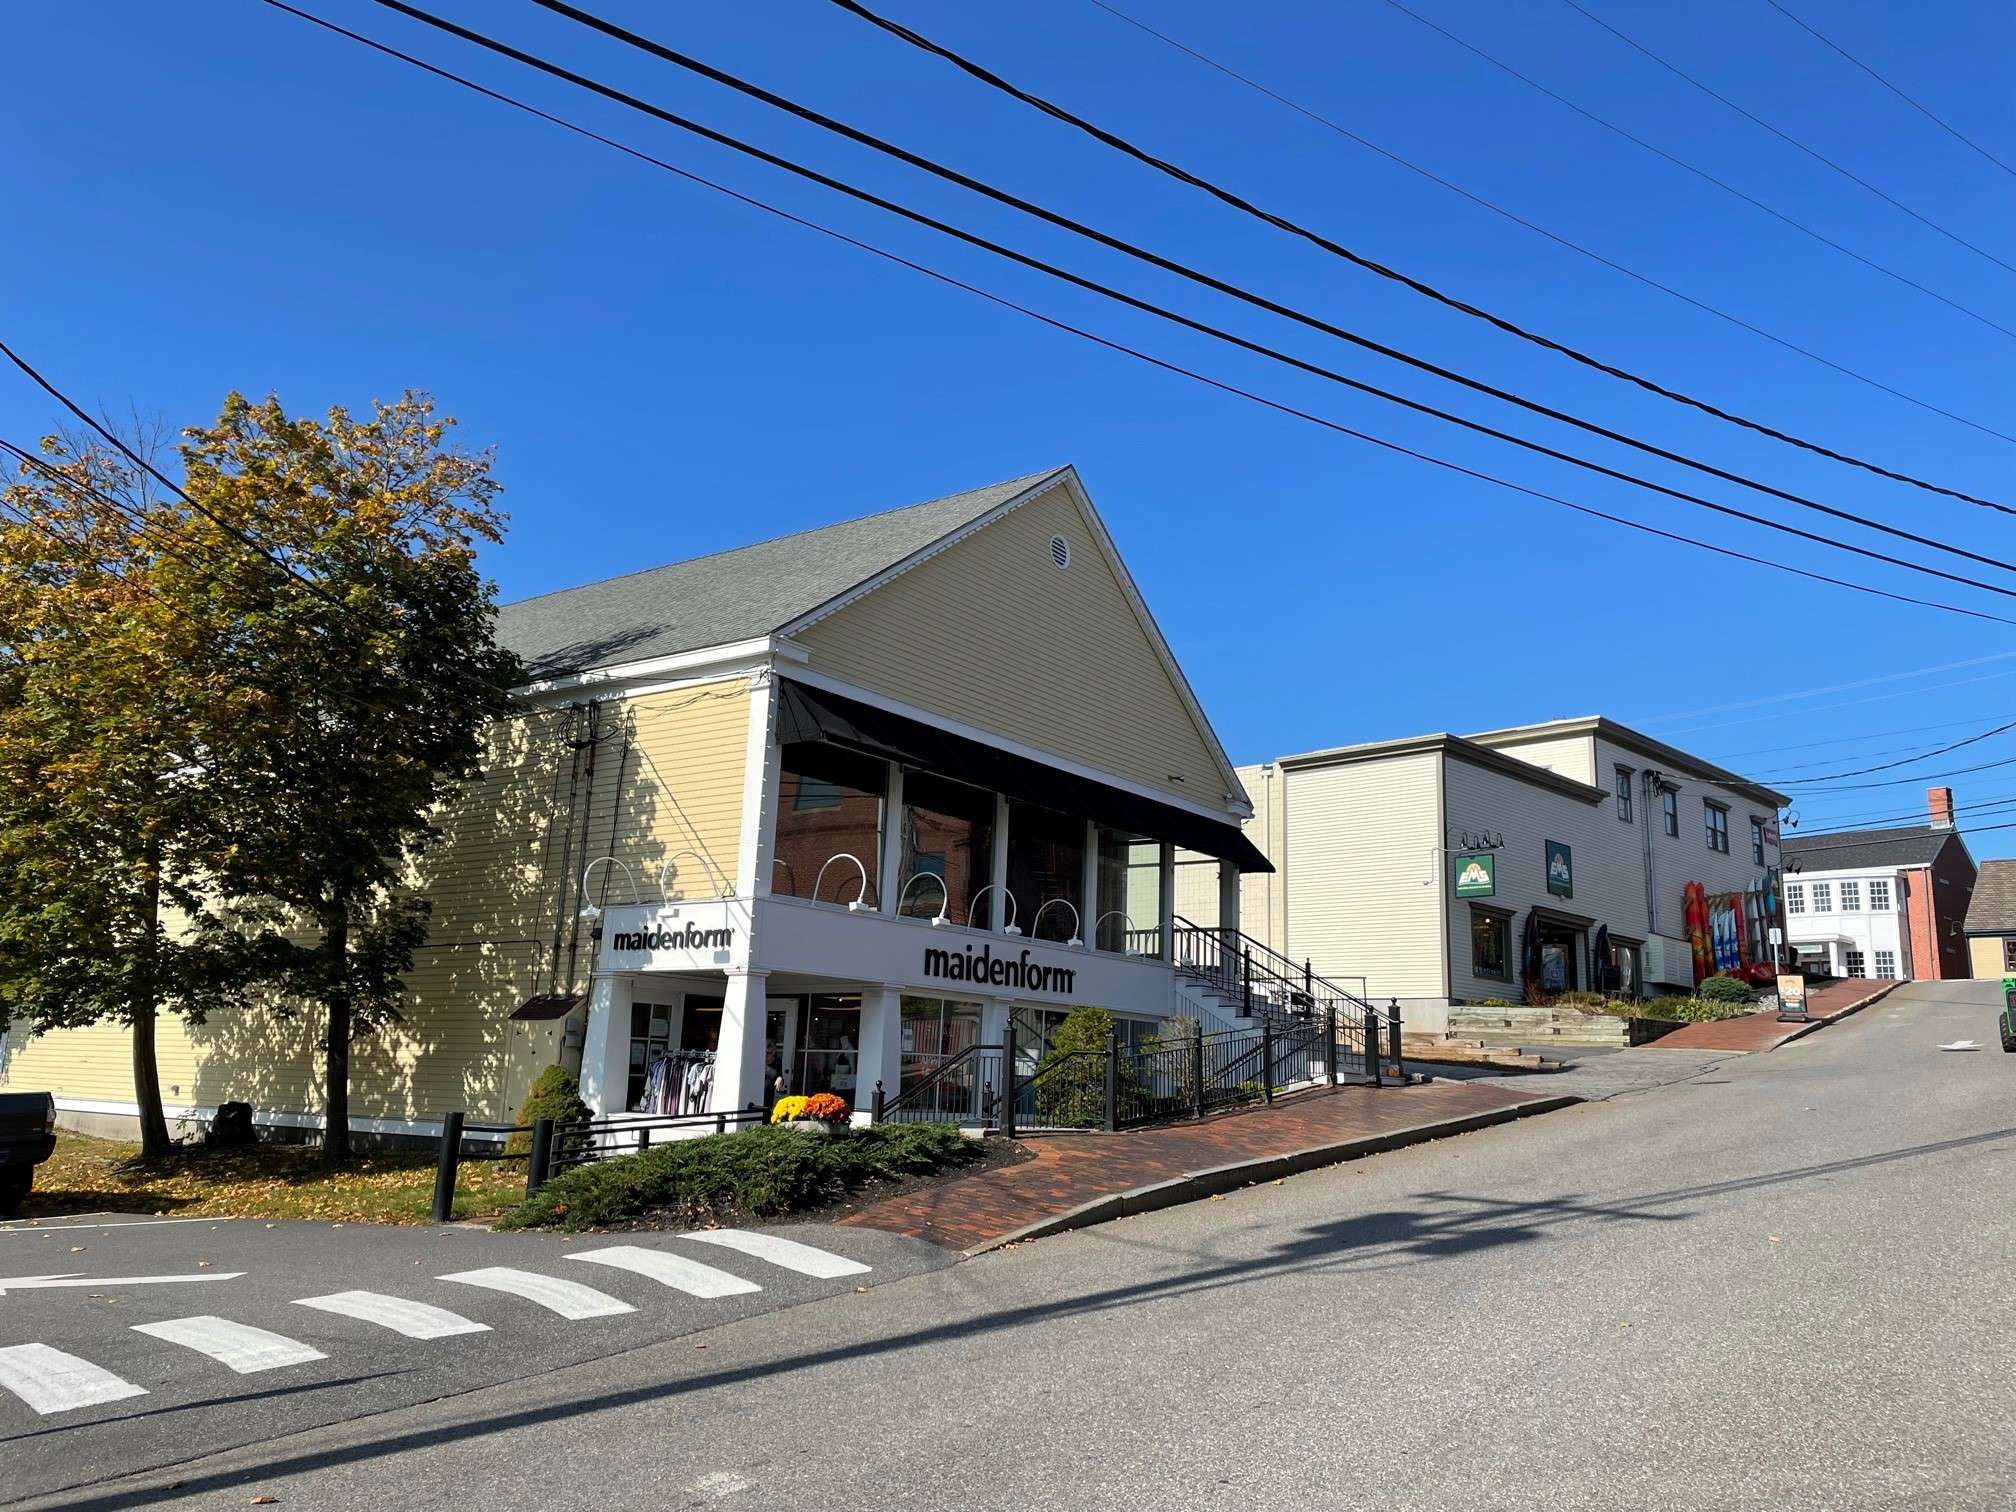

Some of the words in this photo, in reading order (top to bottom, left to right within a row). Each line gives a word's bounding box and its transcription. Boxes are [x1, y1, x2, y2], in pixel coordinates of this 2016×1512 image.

[1458, 867, 1490, 885] EMS
[1550, 860, 1569, 879] EMS
[613, 921, 732, 950] maidenform
[924, 944, 1073, 993] maidenform
